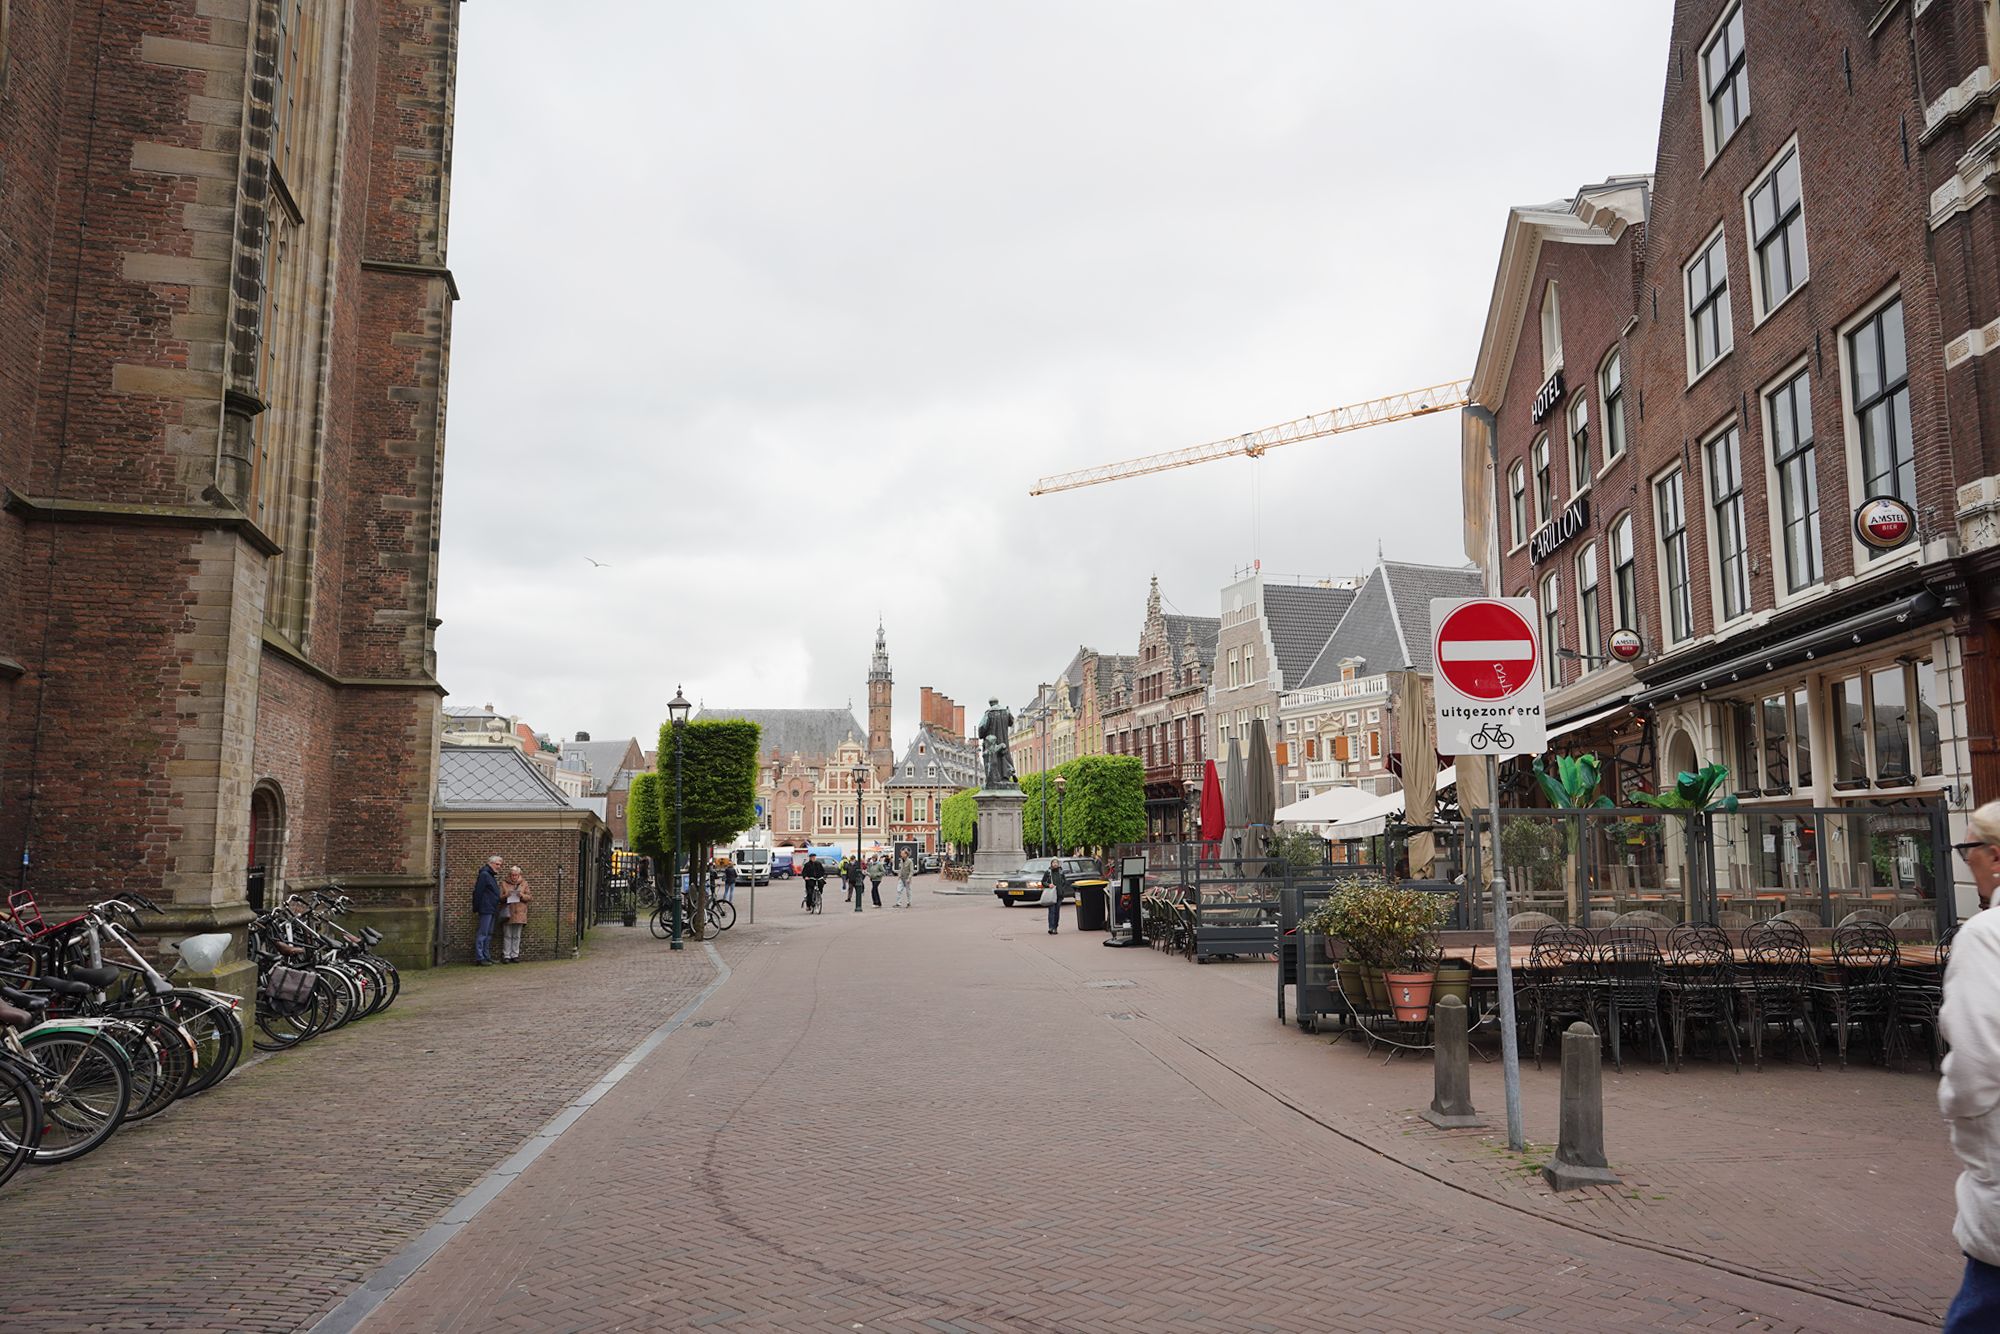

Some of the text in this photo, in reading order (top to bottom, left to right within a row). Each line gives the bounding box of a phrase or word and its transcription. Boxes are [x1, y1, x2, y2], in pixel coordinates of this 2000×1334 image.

[1531, 375, 1561, 425] HOTEL
[1529, 499, 1583, 566] CARILLON
[1871, 514, 1904, 523] AMSTEL
